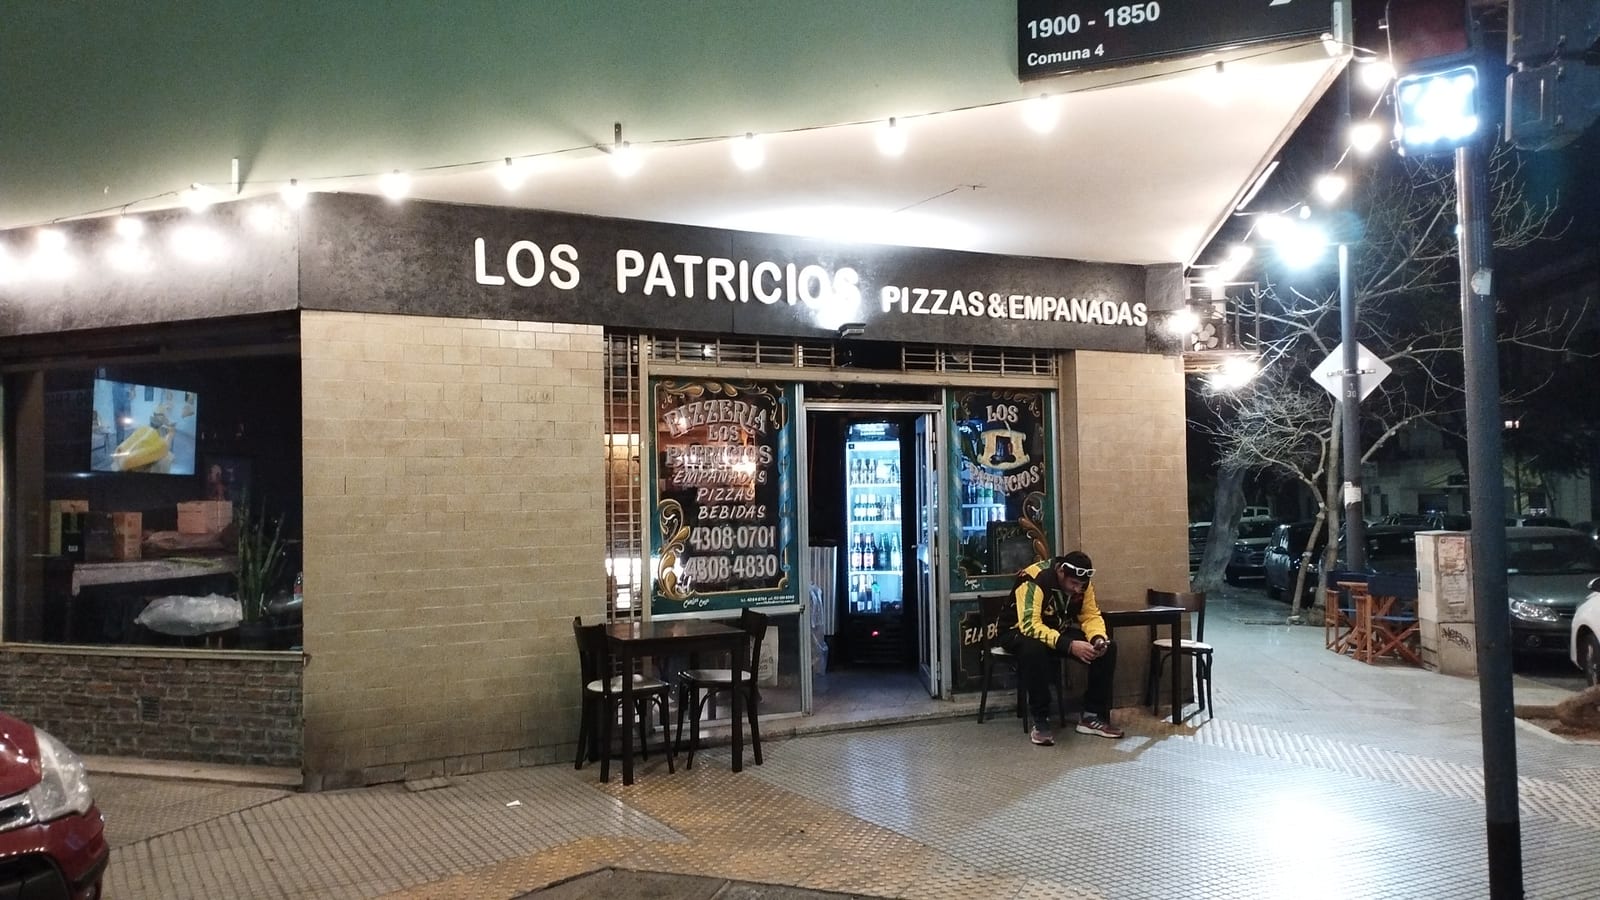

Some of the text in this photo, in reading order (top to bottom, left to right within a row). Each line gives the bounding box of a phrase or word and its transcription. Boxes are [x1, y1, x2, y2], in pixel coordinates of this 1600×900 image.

[1027, 14, 1080, 39] 1900
[1104, 2, 1160, 28] 1850
[1027, 43, 1105, 66] Comuna 4
[474, 237, 860, 313] LOS PATRICIOS
[664, 399, 767, 439] PIZZERIA
[985, 403, 1019, 423] LOS
[707, 425, 740, 442] LOS
[665, 444, 773, 468] PATRICIOS
[672, 469, 768, 486] EMPANADAS
[696, 487, 756, 502] PIZZAS
[697, 504, 767, 520] BEBIDAS
